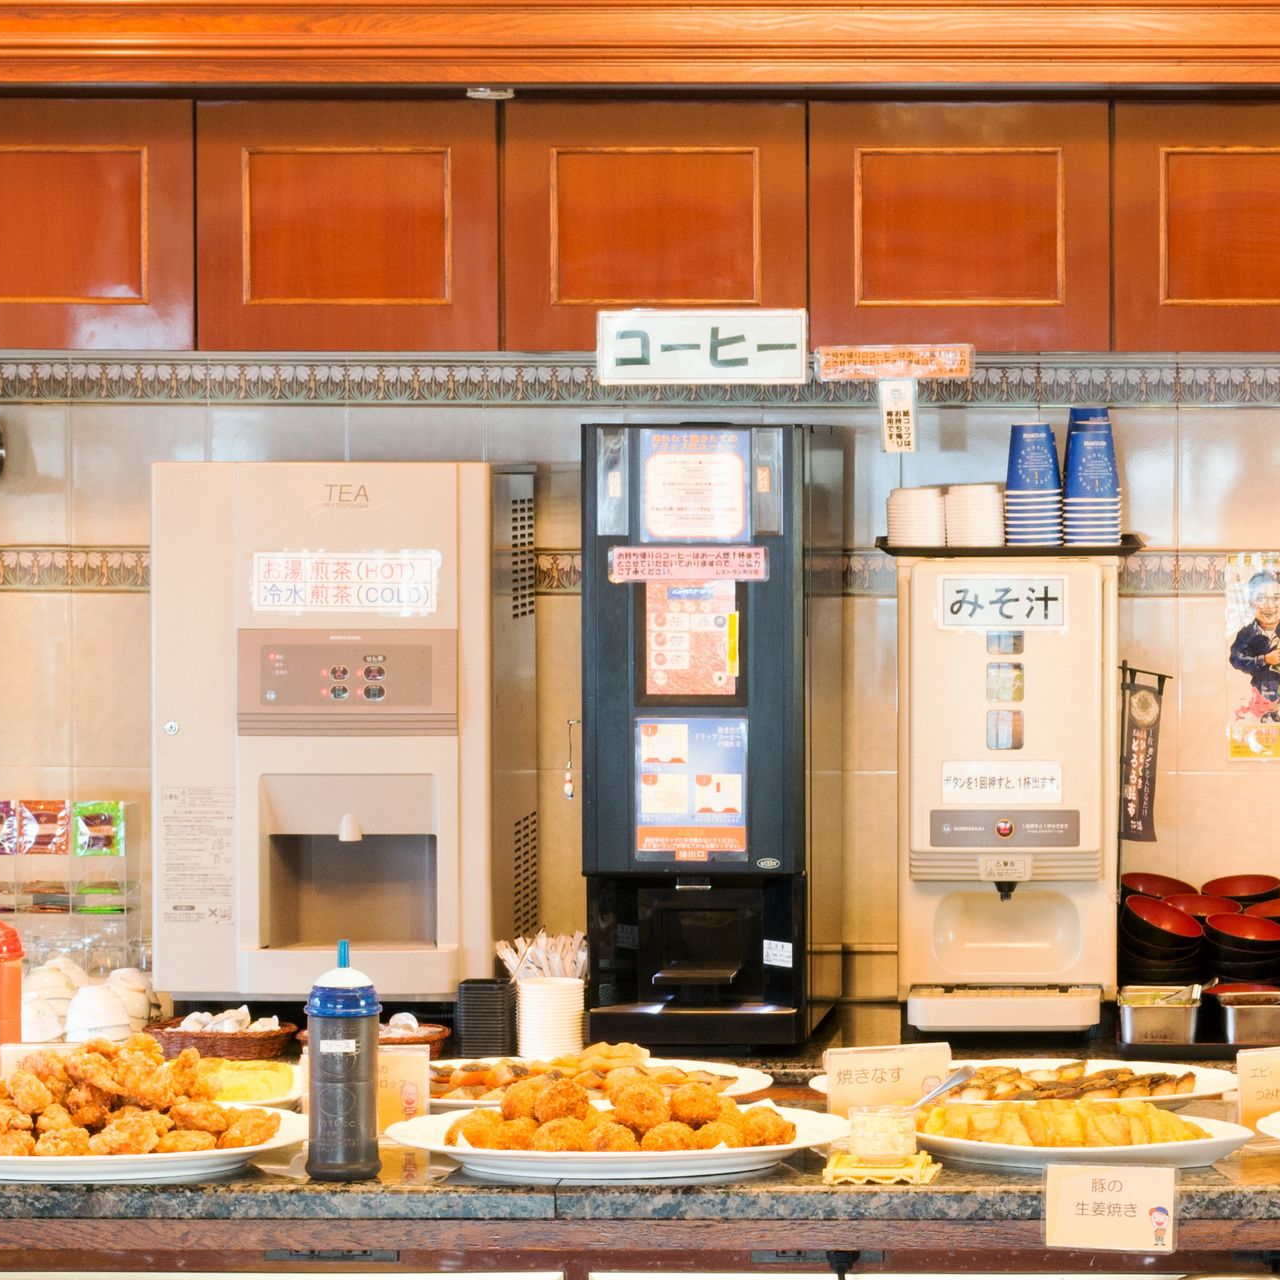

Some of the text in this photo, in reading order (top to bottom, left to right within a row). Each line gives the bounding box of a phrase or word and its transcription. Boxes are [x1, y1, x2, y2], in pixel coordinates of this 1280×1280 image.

[614, 326, 798, 369] コーヒー
[885, 410, 896, 445] 専用です。
[894, 410, 904, 448] お持ち帰り
[902, 410, 912, 451] 紙コップは、
[324, 484, 370, 503] TEA
[262, 559, 303, 581] お湯
[262, 583, 305, 606] 冷水
[949, 585, 1059, 621] みそ汁
[943, 775, 1061, 790] ボタンを1回押すと、1杯出ます。
[836, 1066, 904, 1086] 焼きなす
[1090, 1178, 1124, 1194] 豚の
[1074, 1200, 1139, 1218] 生姜焼き
